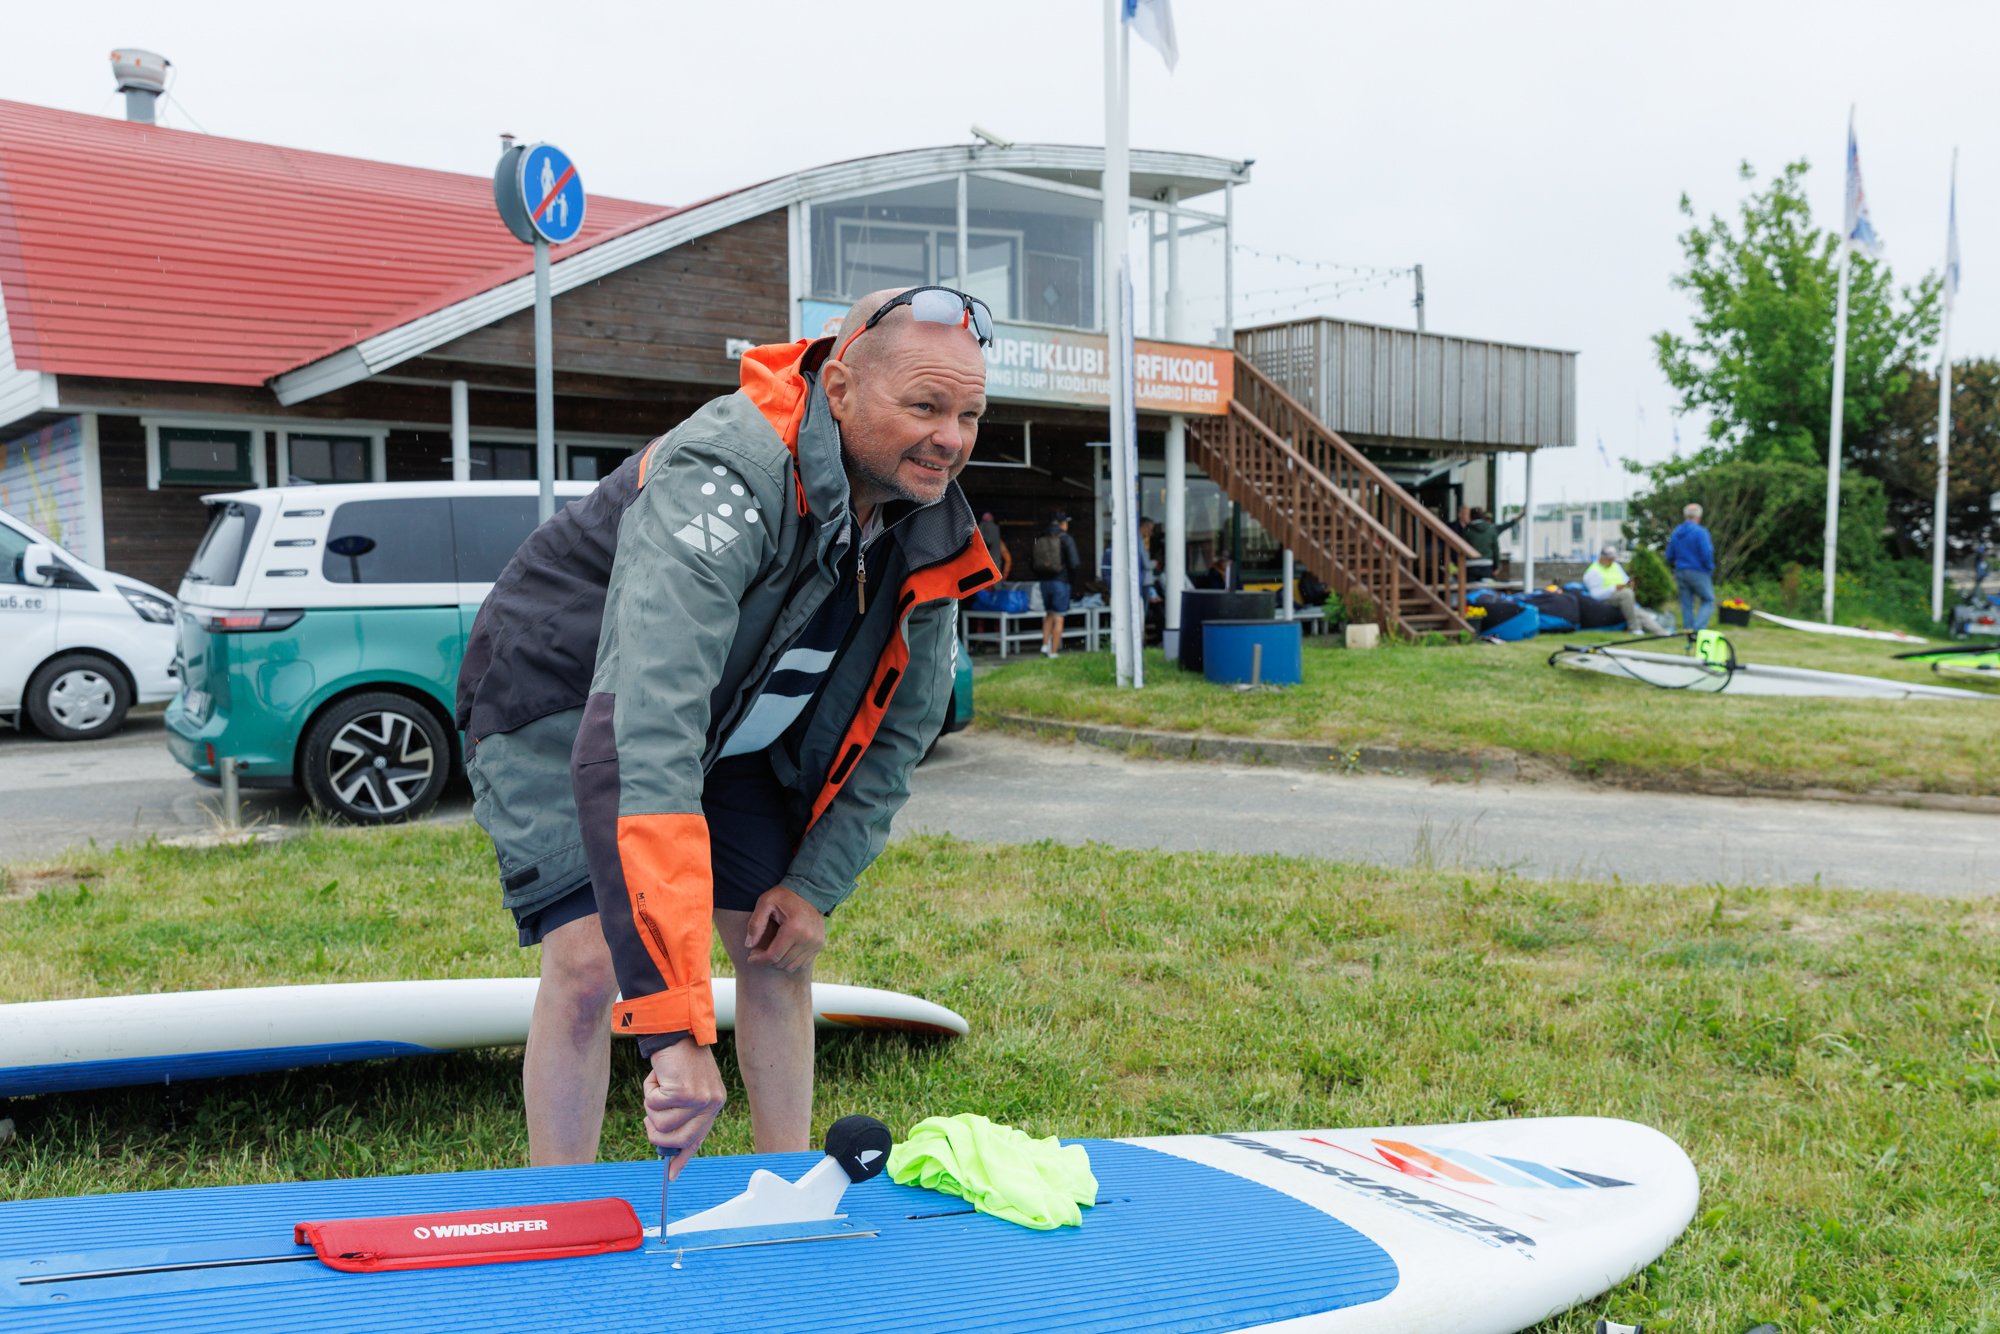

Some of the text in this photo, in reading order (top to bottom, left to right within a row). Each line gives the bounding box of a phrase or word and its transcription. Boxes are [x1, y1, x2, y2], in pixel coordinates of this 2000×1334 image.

[984, 338, 1219, 386] URFIKLUBI RFIKOOL
[1022, 371, 1047, 388] SUP
[1191, 386, 1218, 404] RENT
[431, 1219, 548, 1239] WINDSURFER
